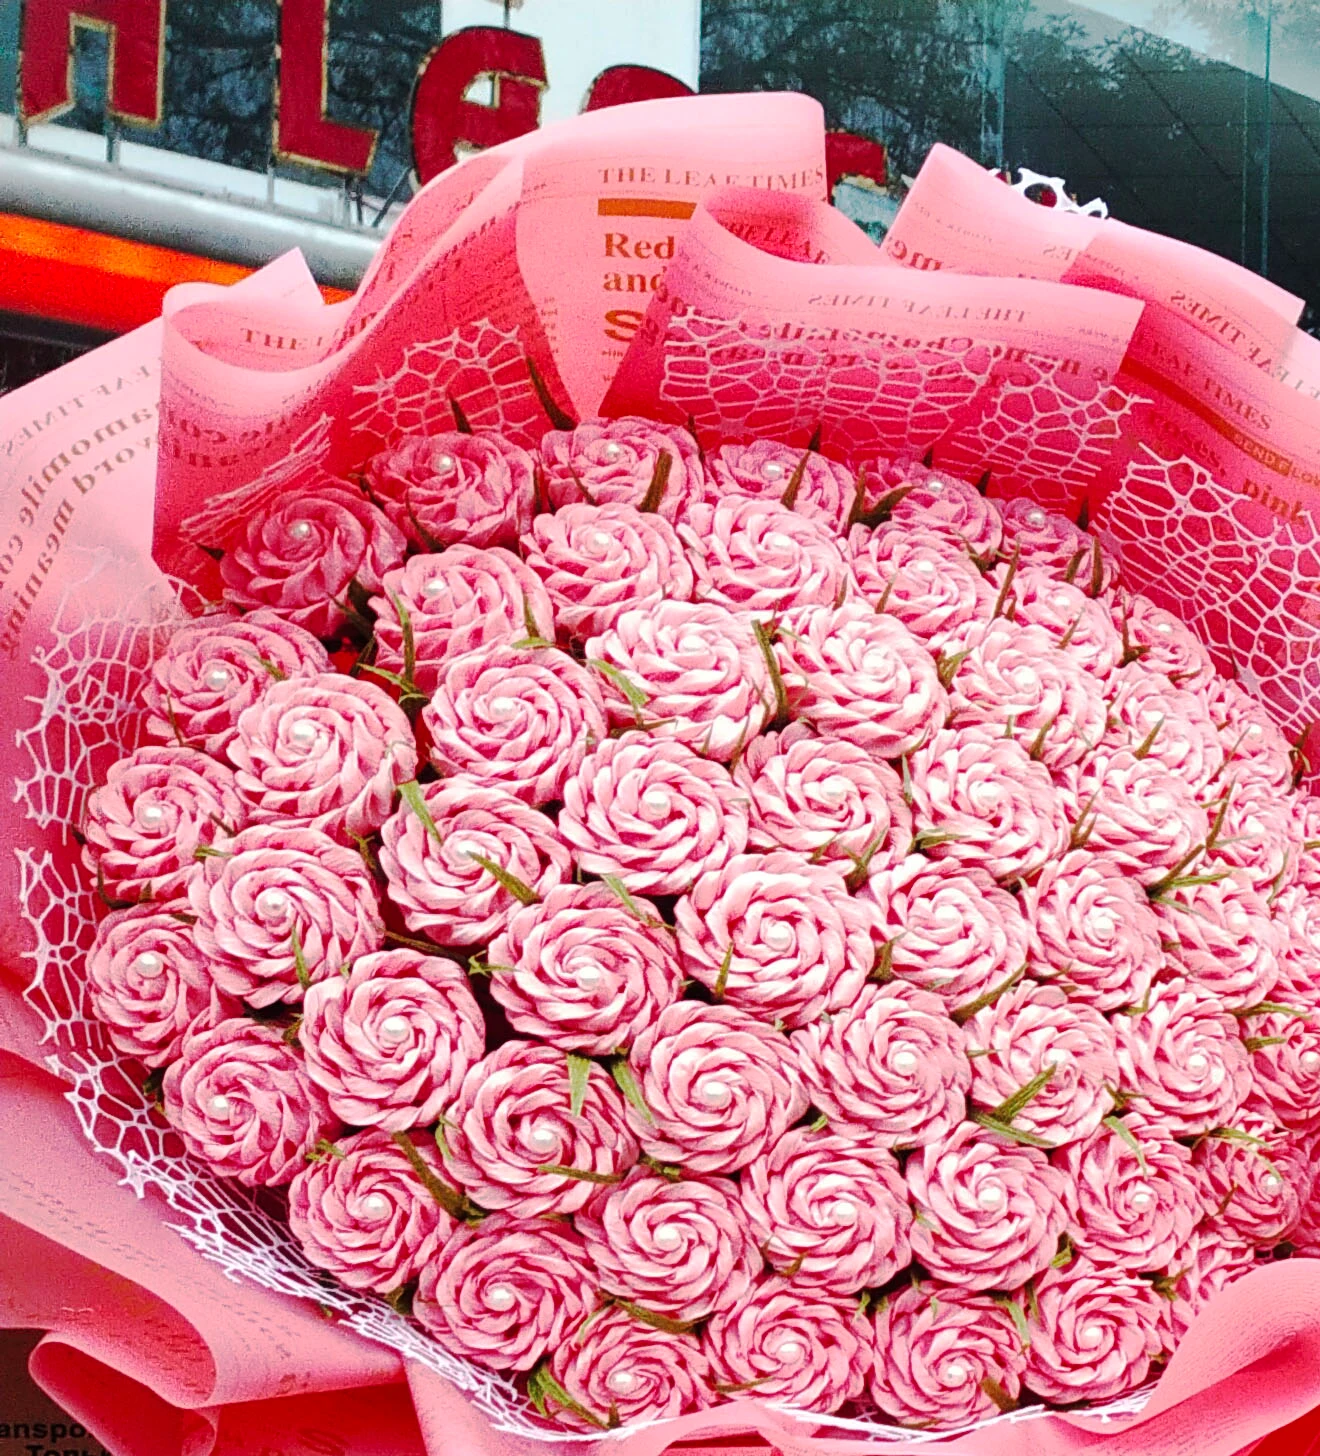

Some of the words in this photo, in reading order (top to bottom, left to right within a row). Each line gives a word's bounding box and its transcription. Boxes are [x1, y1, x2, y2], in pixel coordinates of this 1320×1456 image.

[598, 167, 656, 185] THE
[744, 164, 823, 190] TIMES
[604, 232, 675, 260] Red
[1203, 377, 1273, 431] TIMES
[0, 1422, 89, 1443] anspo
